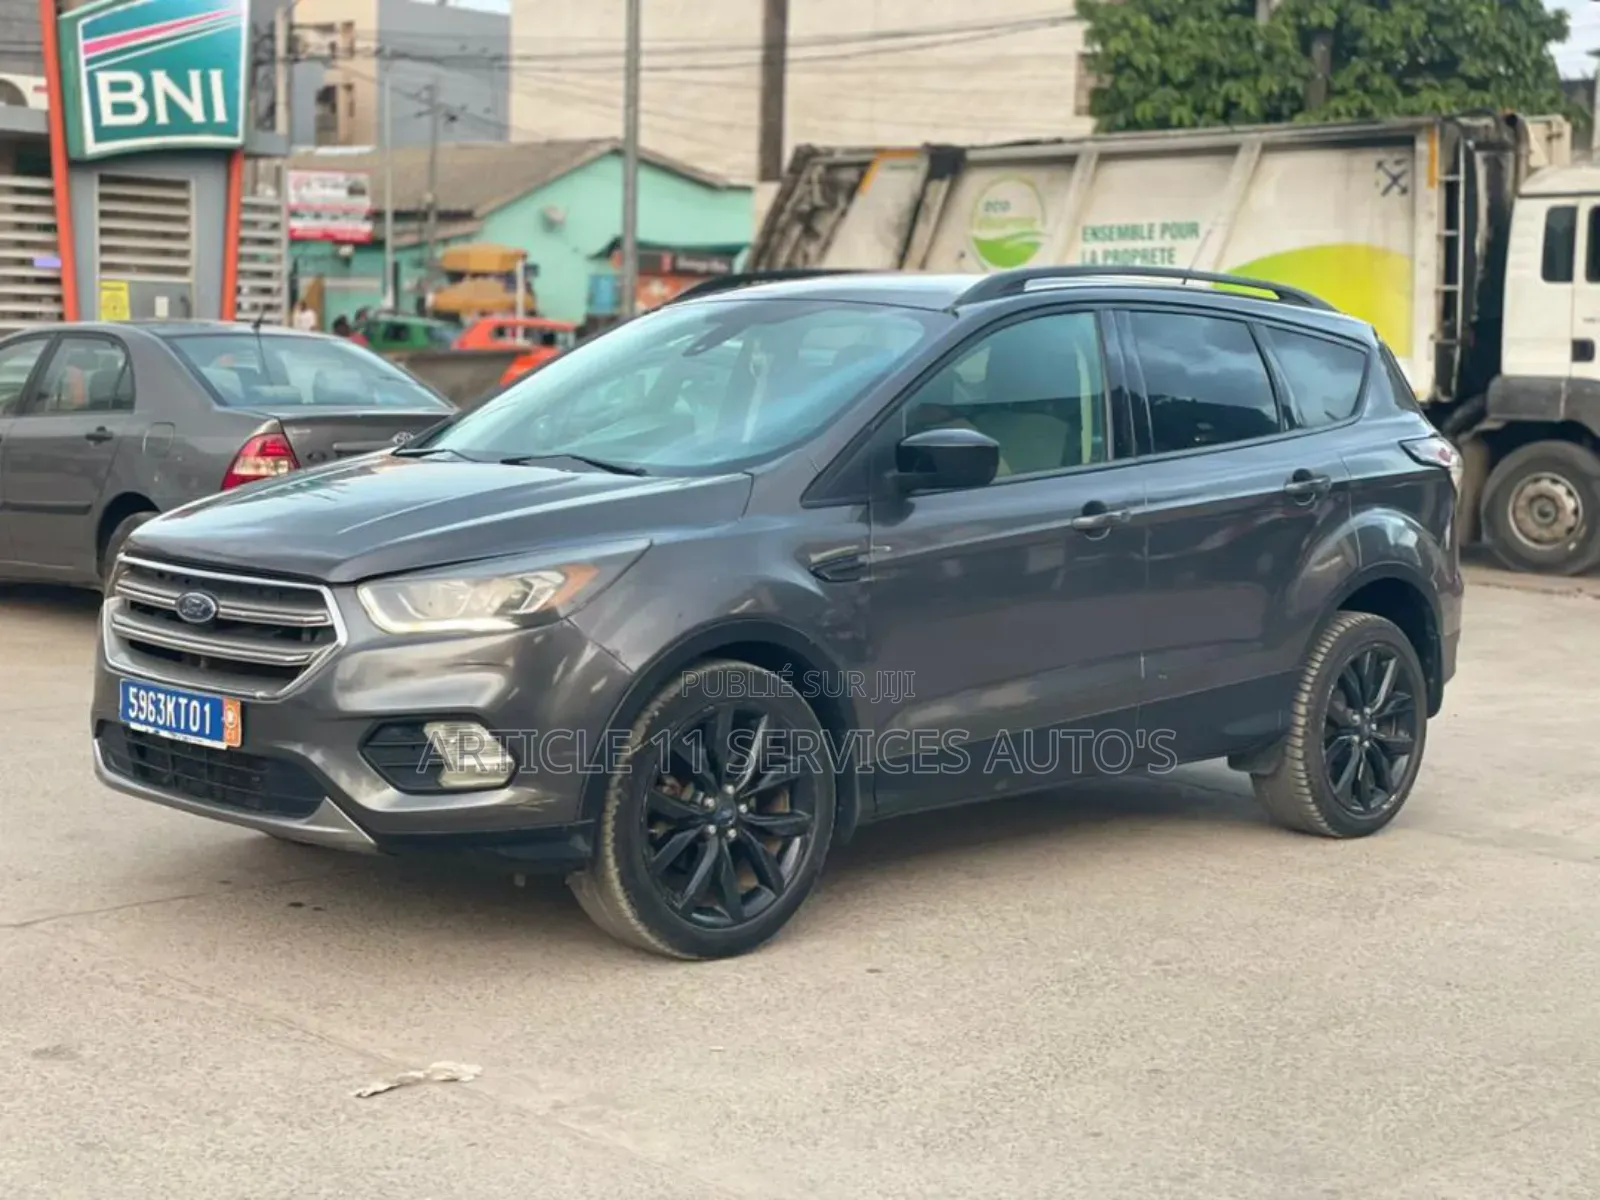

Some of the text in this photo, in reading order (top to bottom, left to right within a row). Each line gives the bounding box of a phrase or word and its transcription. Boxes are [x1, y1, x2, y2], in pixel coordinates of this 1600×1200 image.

[94, 69, 228, 127] BNI
[1081, 221, 1200, 243] ENSEMBLE POUR
[128, 686, 211, 735] 5963KT01
